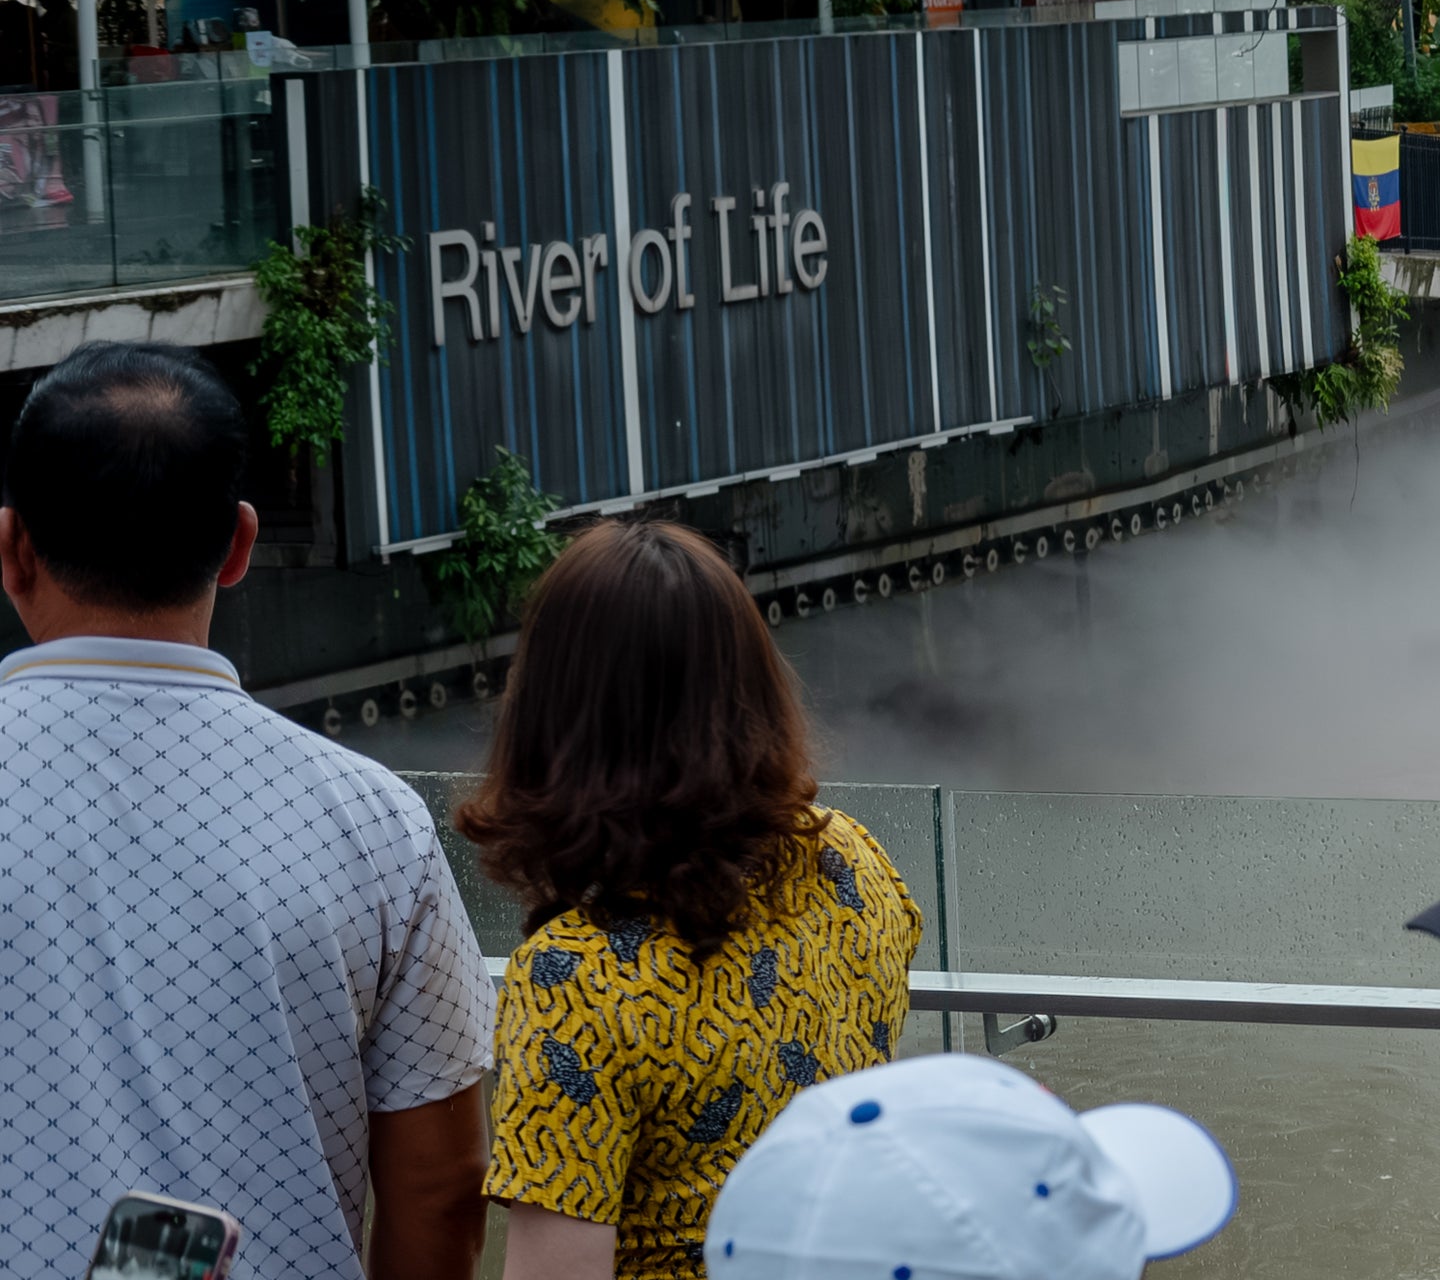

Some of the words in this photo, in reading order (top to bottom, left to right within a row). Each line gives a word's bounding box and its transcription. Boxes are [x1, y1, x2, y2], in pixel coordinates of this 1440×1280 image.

[427, 221, 609, 347] River
[628, 192, 695, 314] of
[710, 180, 829, 303] Life
